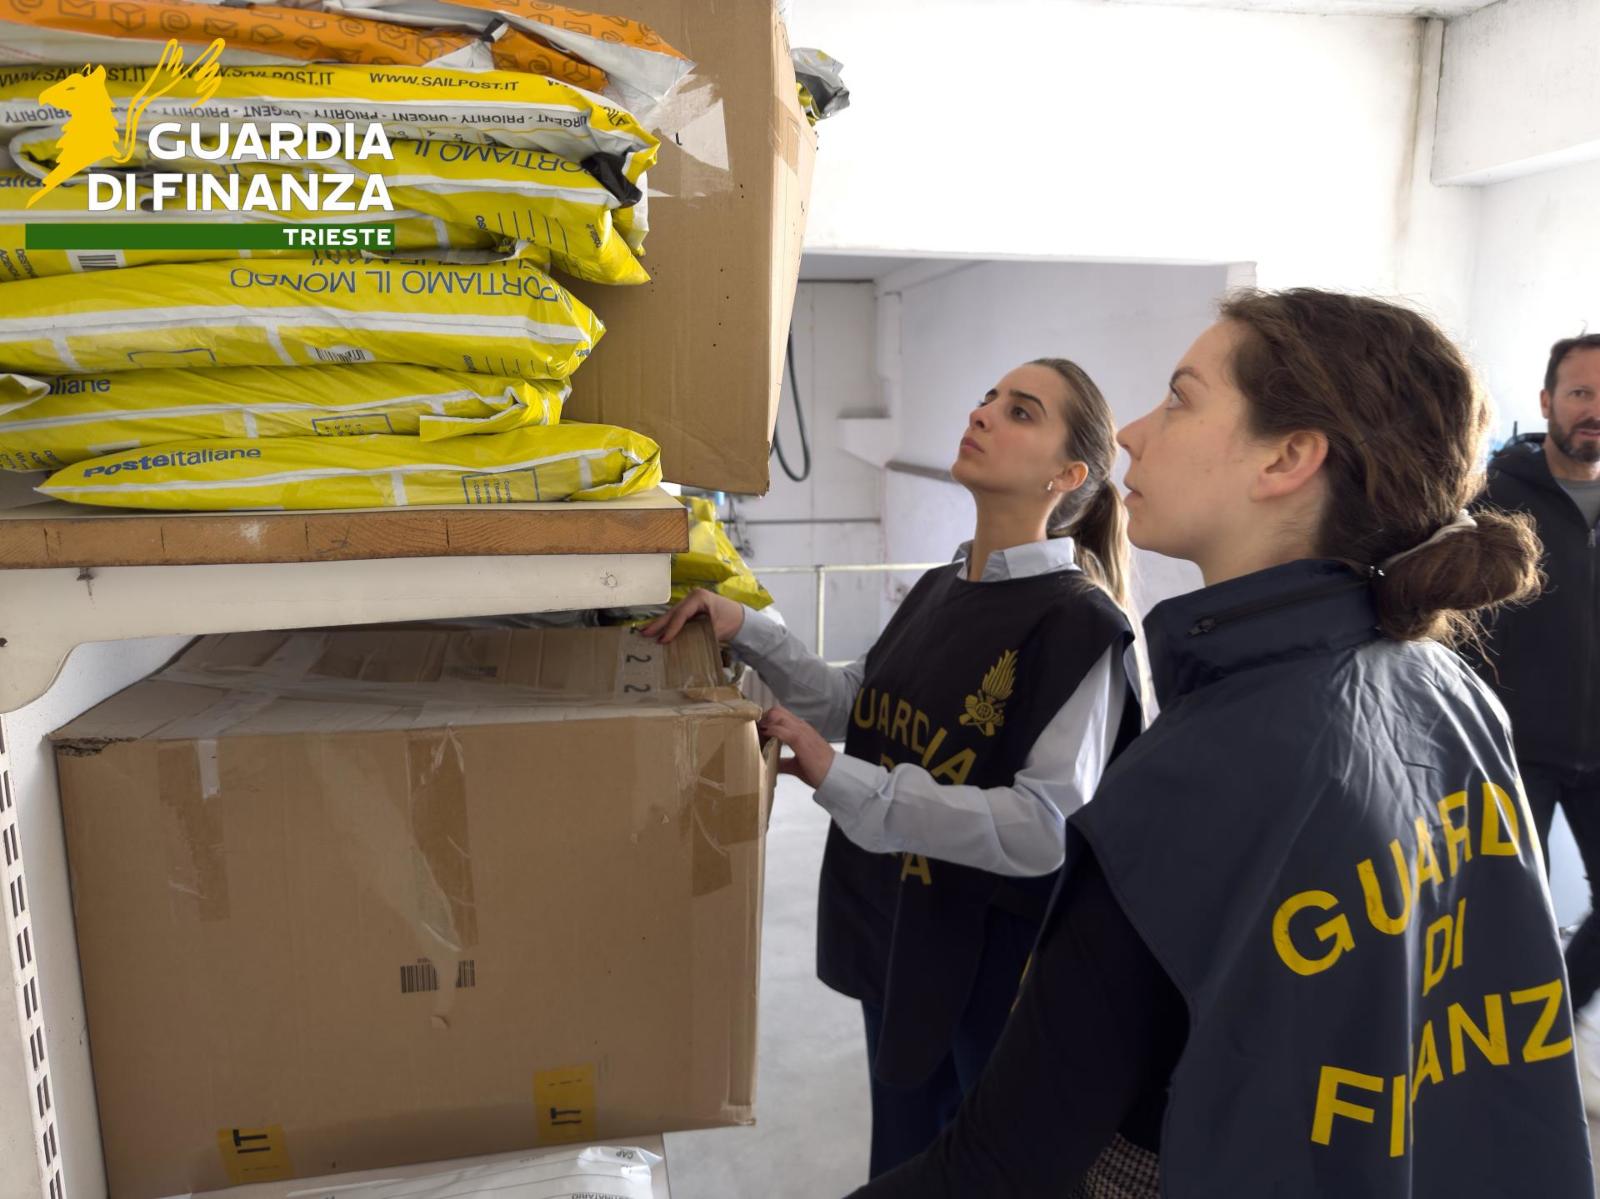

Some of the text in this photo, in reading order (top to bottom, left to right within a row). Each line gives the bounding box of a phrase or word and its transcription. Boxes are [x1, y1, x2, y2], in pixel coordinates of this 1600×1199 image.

[370, 73, 519, 91] WWW.SAILPOST.IT
[314, 109, 378, 120] PRIORITY
[392, 112, 448, 122] URGENT
[461, 113, 525, 124] PRIORITY
[440, 143, 592, 176] ORTIAMO
[230, 267, 558, 302] PORTIAMO IL MONDO
[853, 688, 977, 785] UARDIA
[1272, 782, 1520, 976] GUARD
[1422, 898, 1466, 997] DI
[1311, 979, 1573, 1158] FIANZ
